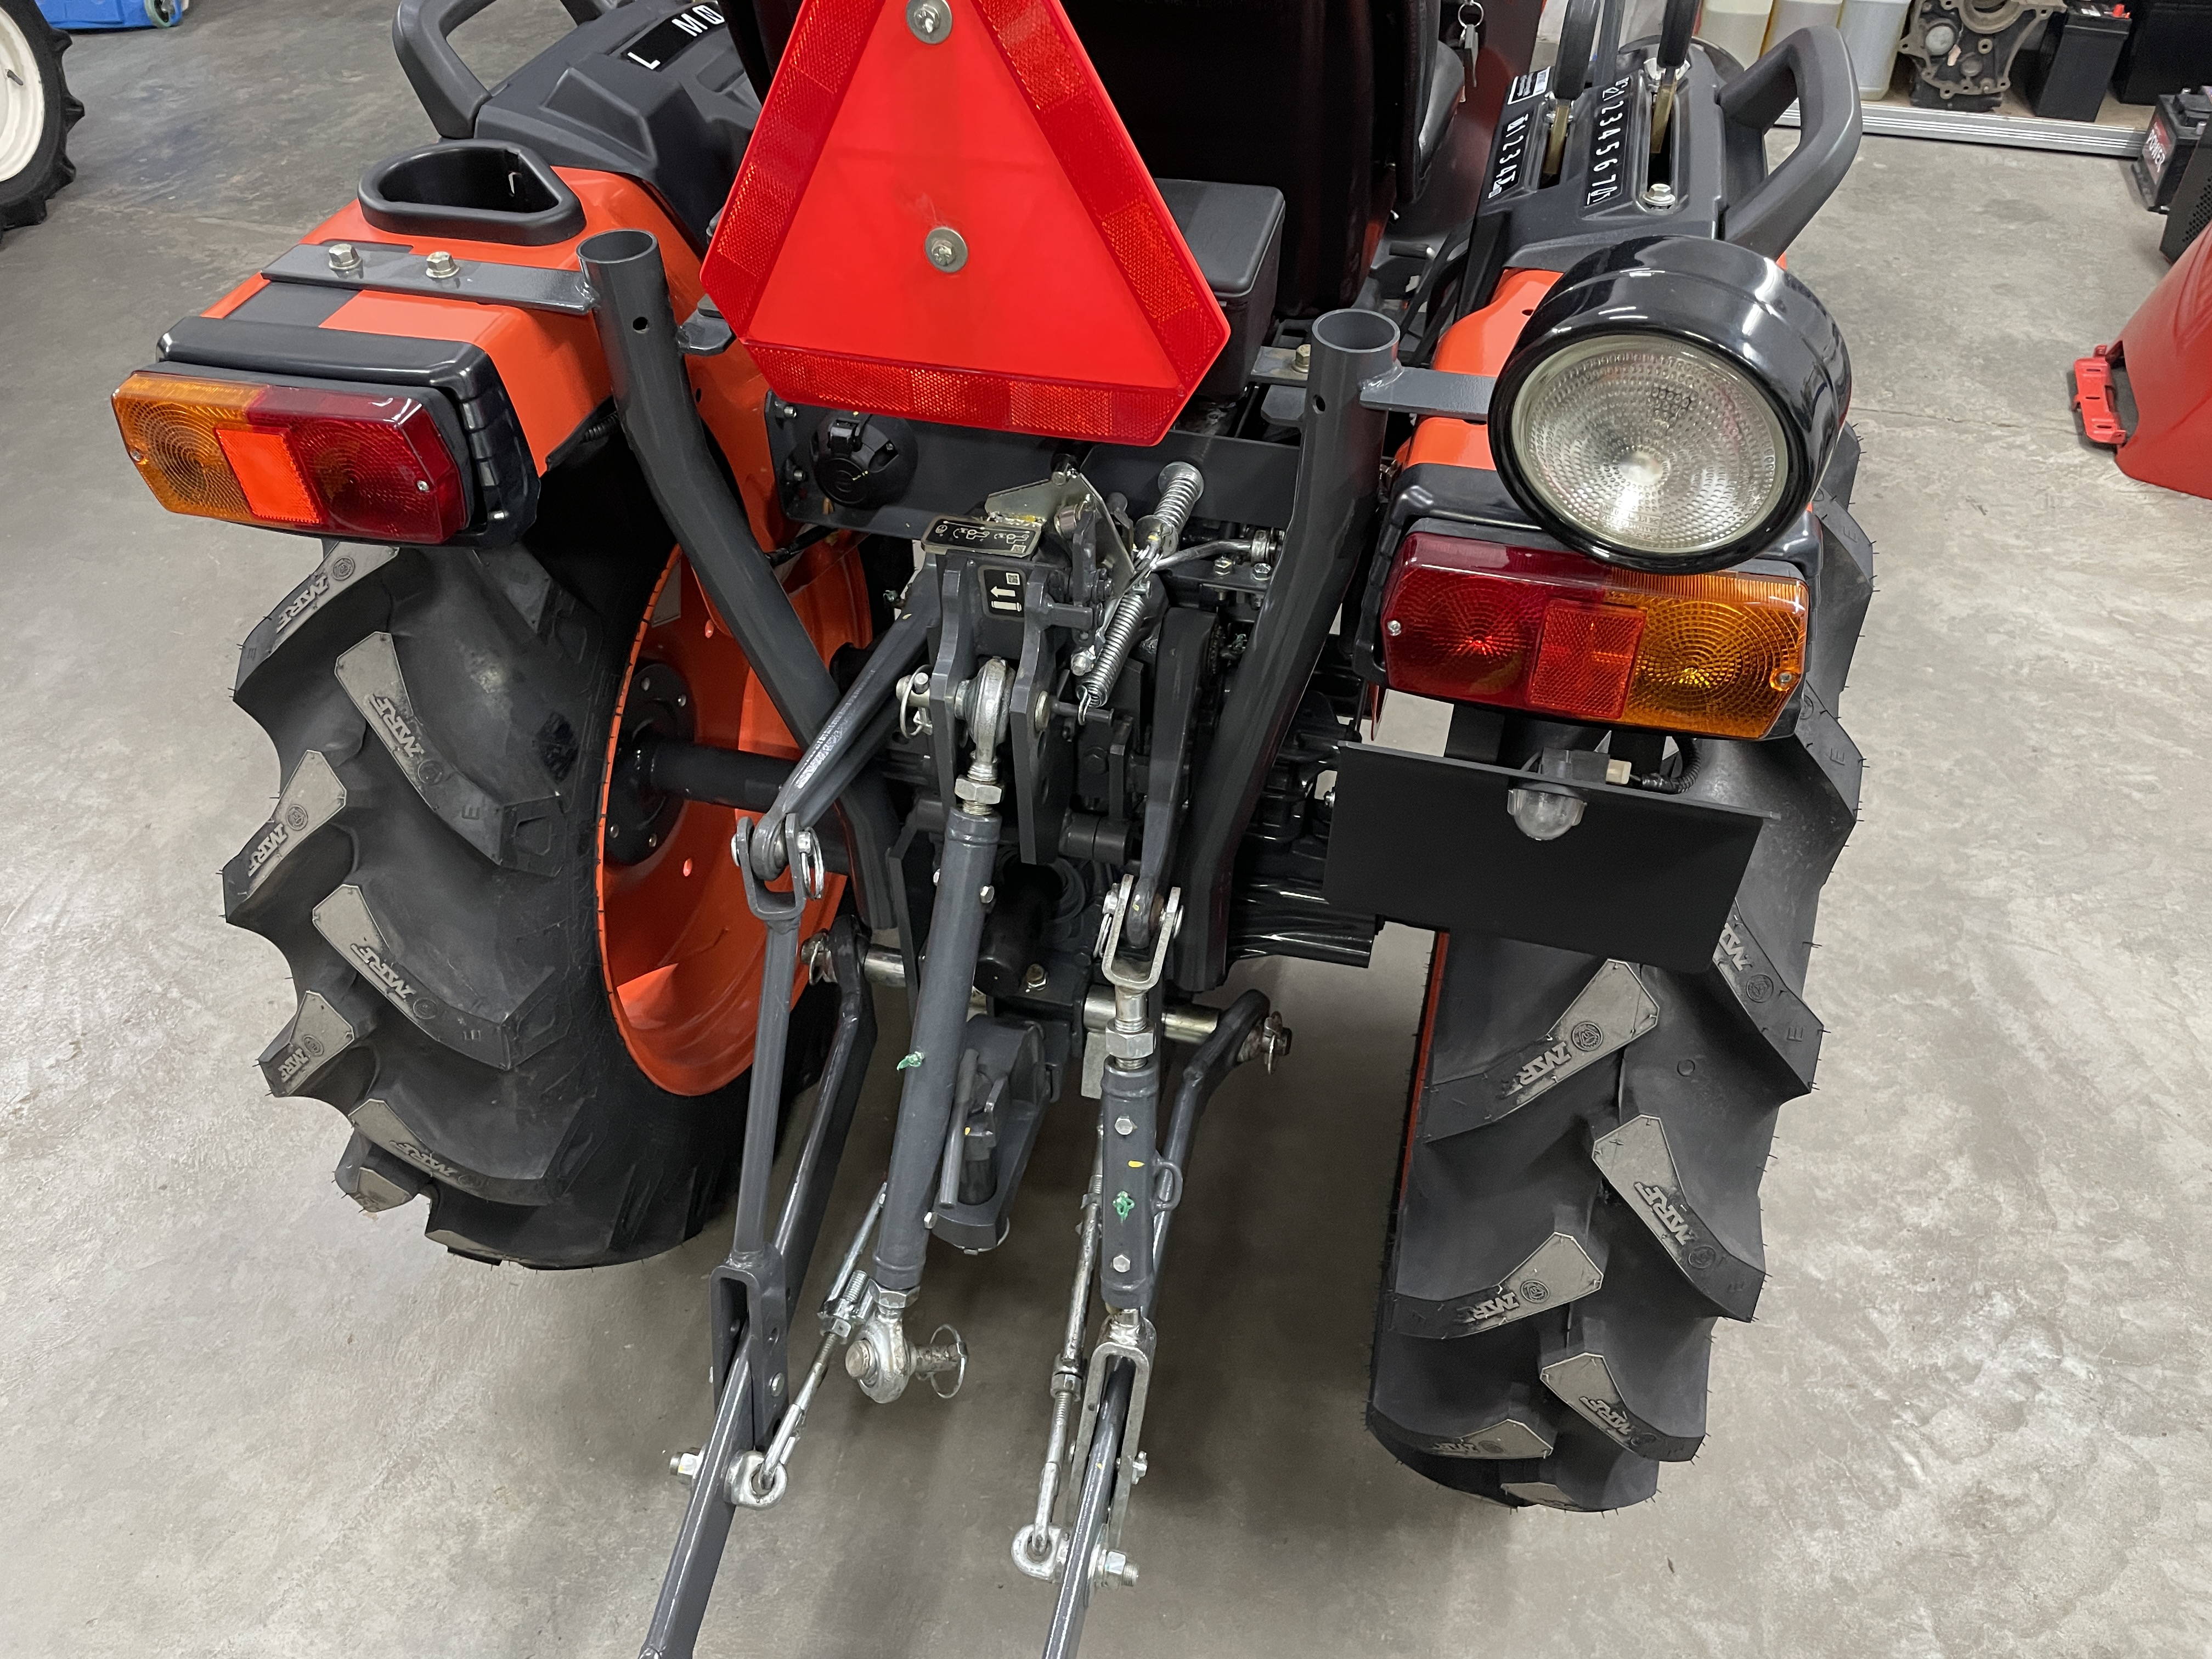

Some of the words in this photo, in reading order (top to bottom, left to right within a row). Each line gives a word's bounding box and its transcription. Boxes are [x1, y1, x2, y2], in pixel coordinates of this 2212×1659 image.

[627, 52, 661, 70] L
[672, 13, 708, 37] M
[1601, 100, 1624, 114] 2
[1600, 112, 1622, 127] 3
[1505, 125, 1526, 138] 1
[1598, 128, 1621, 140] 4
[1503, 135, 1523, 151] 2
[1596, 141, 1620, 155] 5
[2146, 128, 2165, 173] POWER
[1499, 149, 1521, 164] 3
[1496, 165, 1517, 178] 4
[1593, 159, 1618, 172] 6
[1592, 174, 1616, 187] 7
[1843, 526, 1858, 543] E
[276, 575, 329, 633] MRF
[368, 693, 424, 758] MRF
[1830, 748, 1845, 766] E
[461, 805, 480, 820] E
[247, 823, 287, 877] MRF
[350, 944, 416, 998] MRF
[1787, 1026, 1803, 1042] E
[278, 1047, 308, 1083] MRF
[388, 1141, 458, 1177] MRF
[1634, 1182, 1696, 1246] MRF
[1459, 1291, 1520, 1324] MR
[1579, 1397, 1634, 1435] MRF
